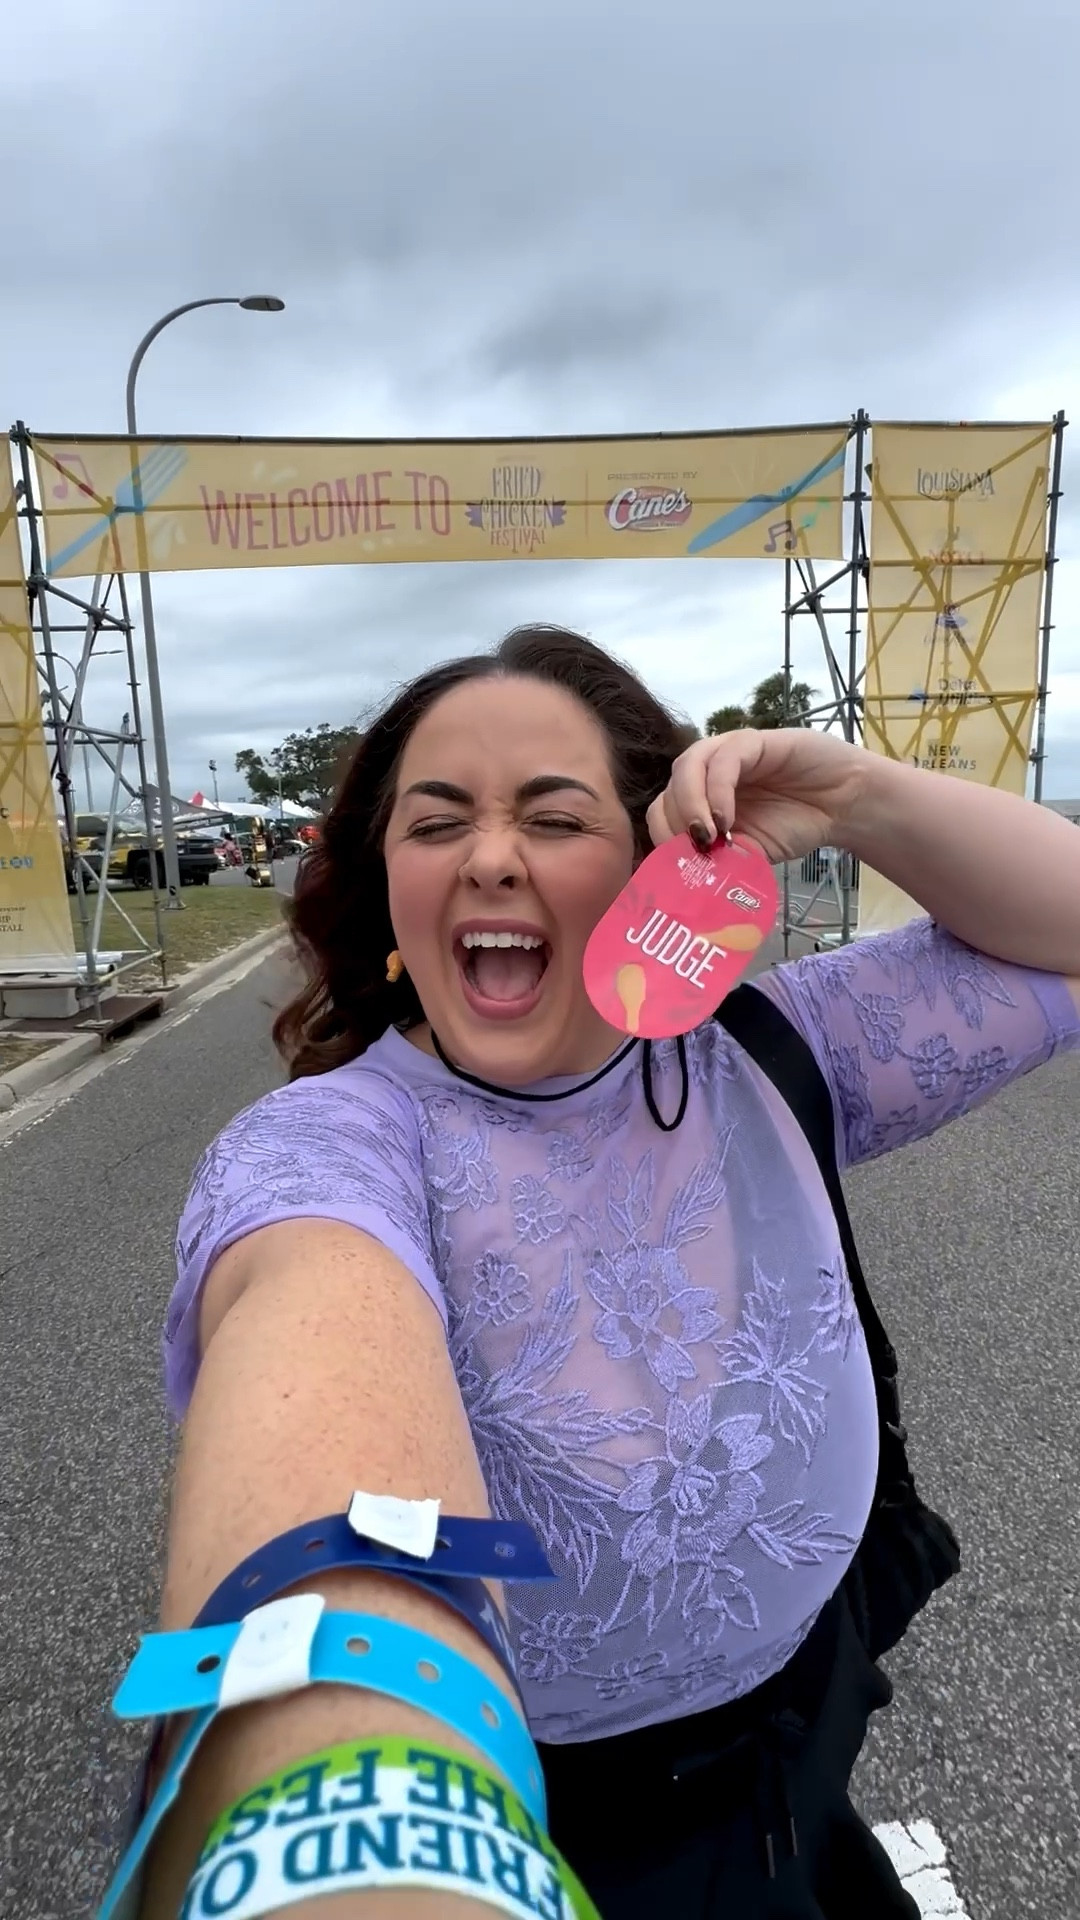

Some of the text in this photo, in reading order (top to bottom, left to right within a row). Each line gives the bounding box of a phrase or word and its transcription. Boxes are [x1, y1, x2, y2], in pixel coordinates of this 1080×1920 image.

[682, 470, 698, 479] BY
[917, 467, 995, 501] LOUISIANA
[200, 471, 450, 550] WELCOME TO
[480, 495, 556, 531] CHICKEN
[607, 487, 691, 531] Cane's
[927, 744, 961, 757] NEW
[626, 908, 728, 989] JUDGE
[201, 1747, 559, 1869] THE FES
[178, 1812, 564, 1920] FRIEND O
